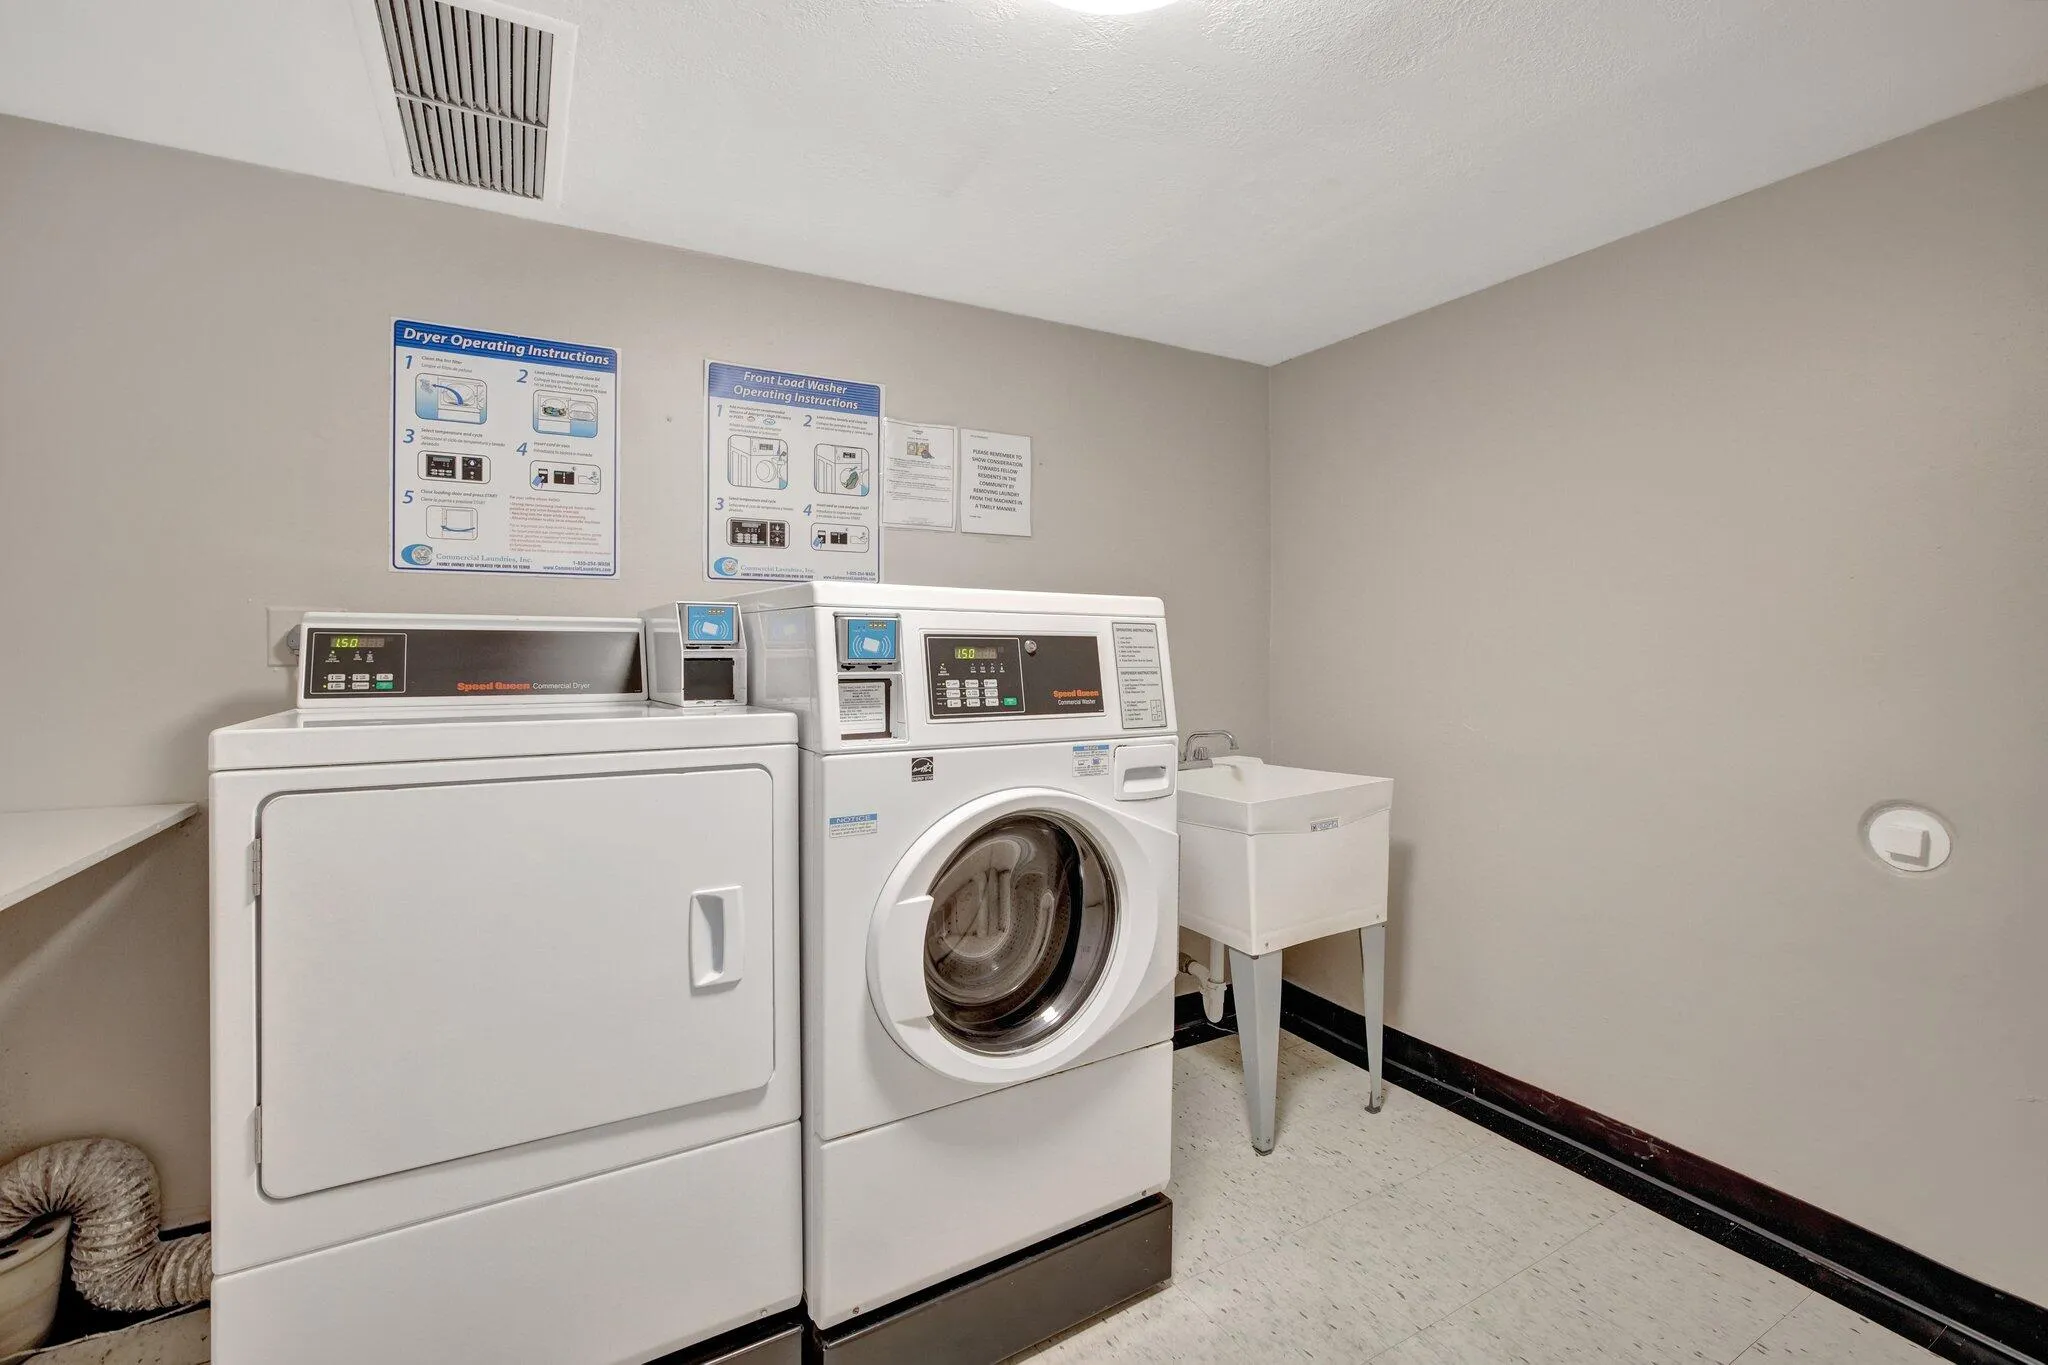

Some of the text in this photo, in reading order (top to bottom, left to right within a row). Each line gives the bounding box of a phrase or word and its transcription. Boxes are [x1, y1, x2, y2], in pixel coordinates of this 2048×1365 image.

[404, 327, 610, 365] Dryer Operating Instructions
[405, 355, 412, 369] 1
[516, 369, 528, 383] 2
[744, 371, 847, 394] Front Load Washer
[733, 385, 858, 410] Operating Instructions
[717, 404, 722, 417] 1
[803, 415, 812, 427] 2
[403, 428, 415, 443] 3
[516, 442, 528, 456] 4
[987, 459, 1023, 467] CONSIDERATION
[403, 490, 414, 504] 5
[714, 497, 724, 510] 3
[803, 504, 812, 516] 4
[457, 682, 493, 691] Speed
[495, 682, 530, 690] Queen
[1053, 690, 1076, 698] Speed
[837, 814, 870, 823] NOTICE
